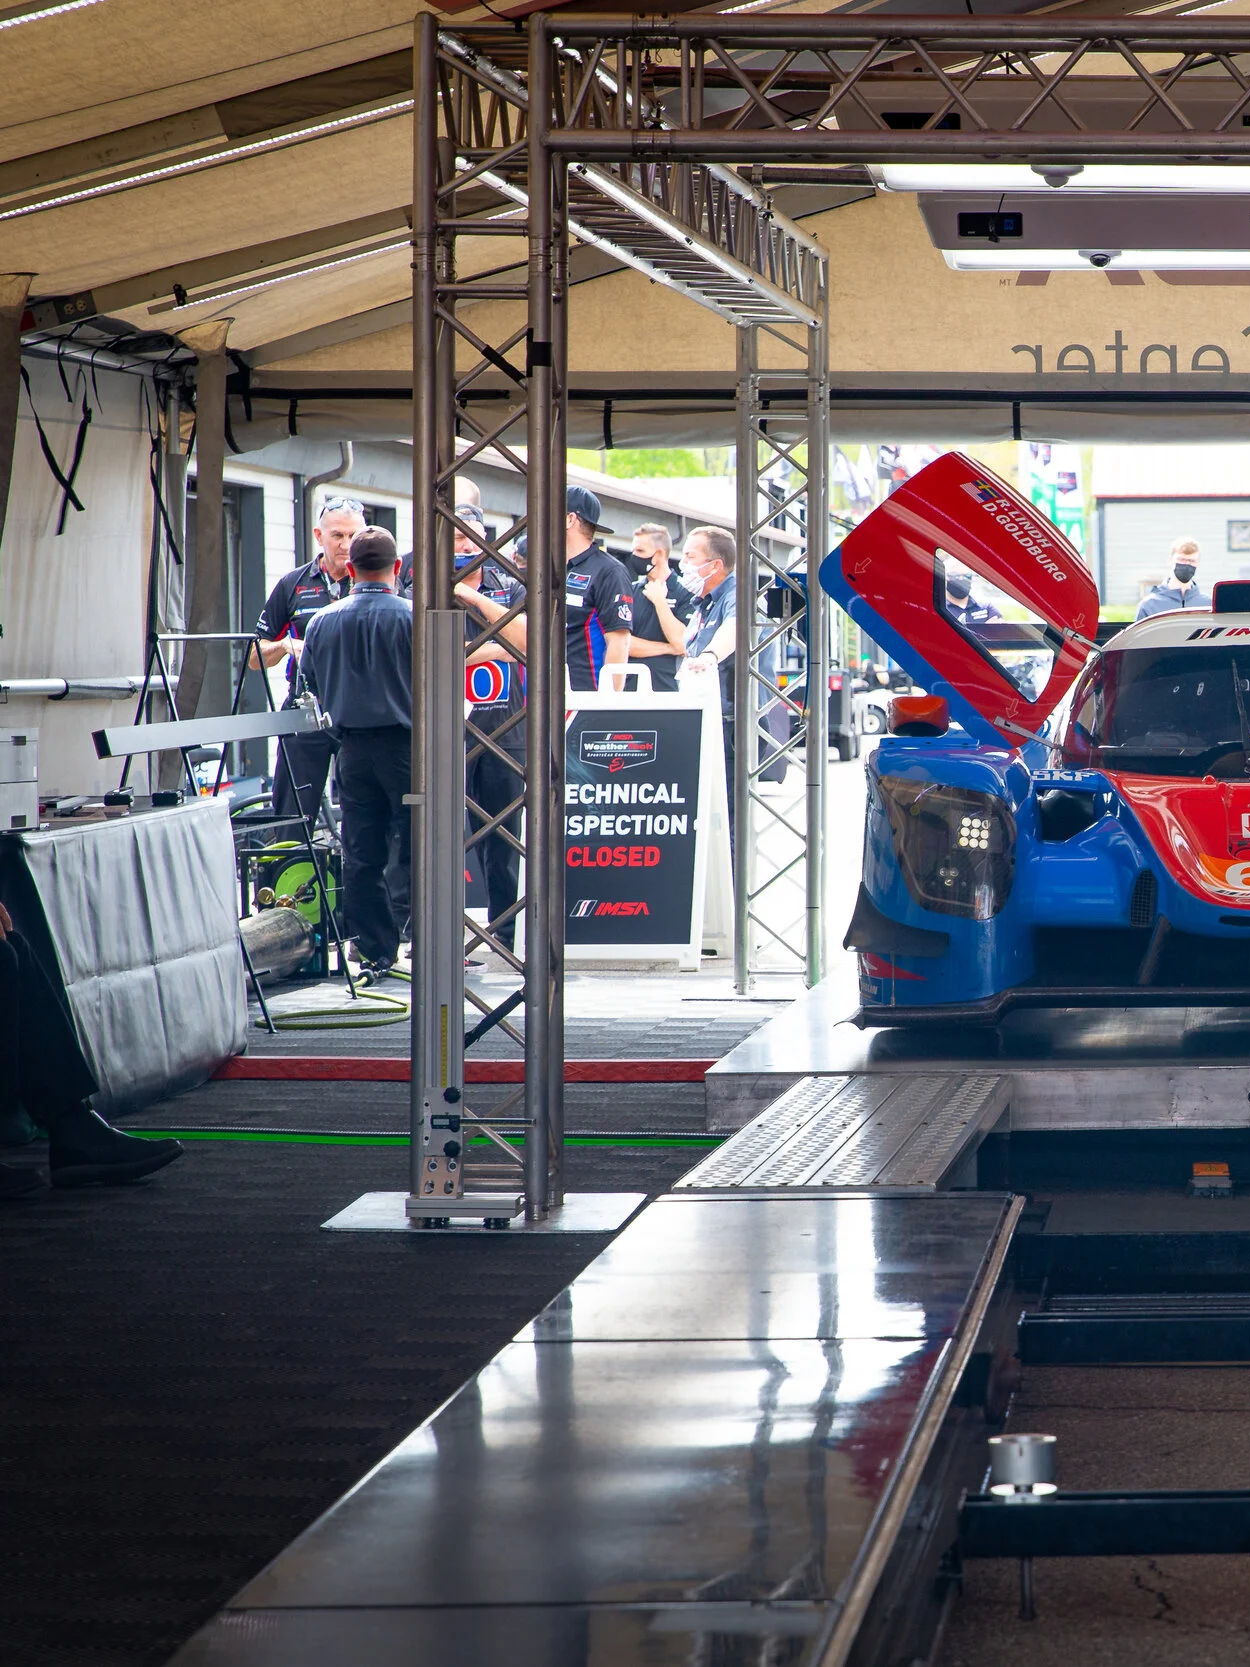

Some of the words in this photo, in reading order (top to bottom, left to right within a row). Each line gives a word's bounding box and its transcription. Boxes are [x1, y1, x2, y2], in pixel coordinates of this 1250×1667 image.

[995, 498, 1052, 548] R.LINDH
[982, 502, 1067, 582] D.GOLDBURG
[584, 742, 653, 750] WeatherTech
[1031, 770, 1095, 781] SKF
[565, 783, 686, 804] ECHNICAL
[565, 814, 688, 835] SPECTION
[566, 846, 661, 867] CLOSED
[594, 901, 650, 916] IMSA
